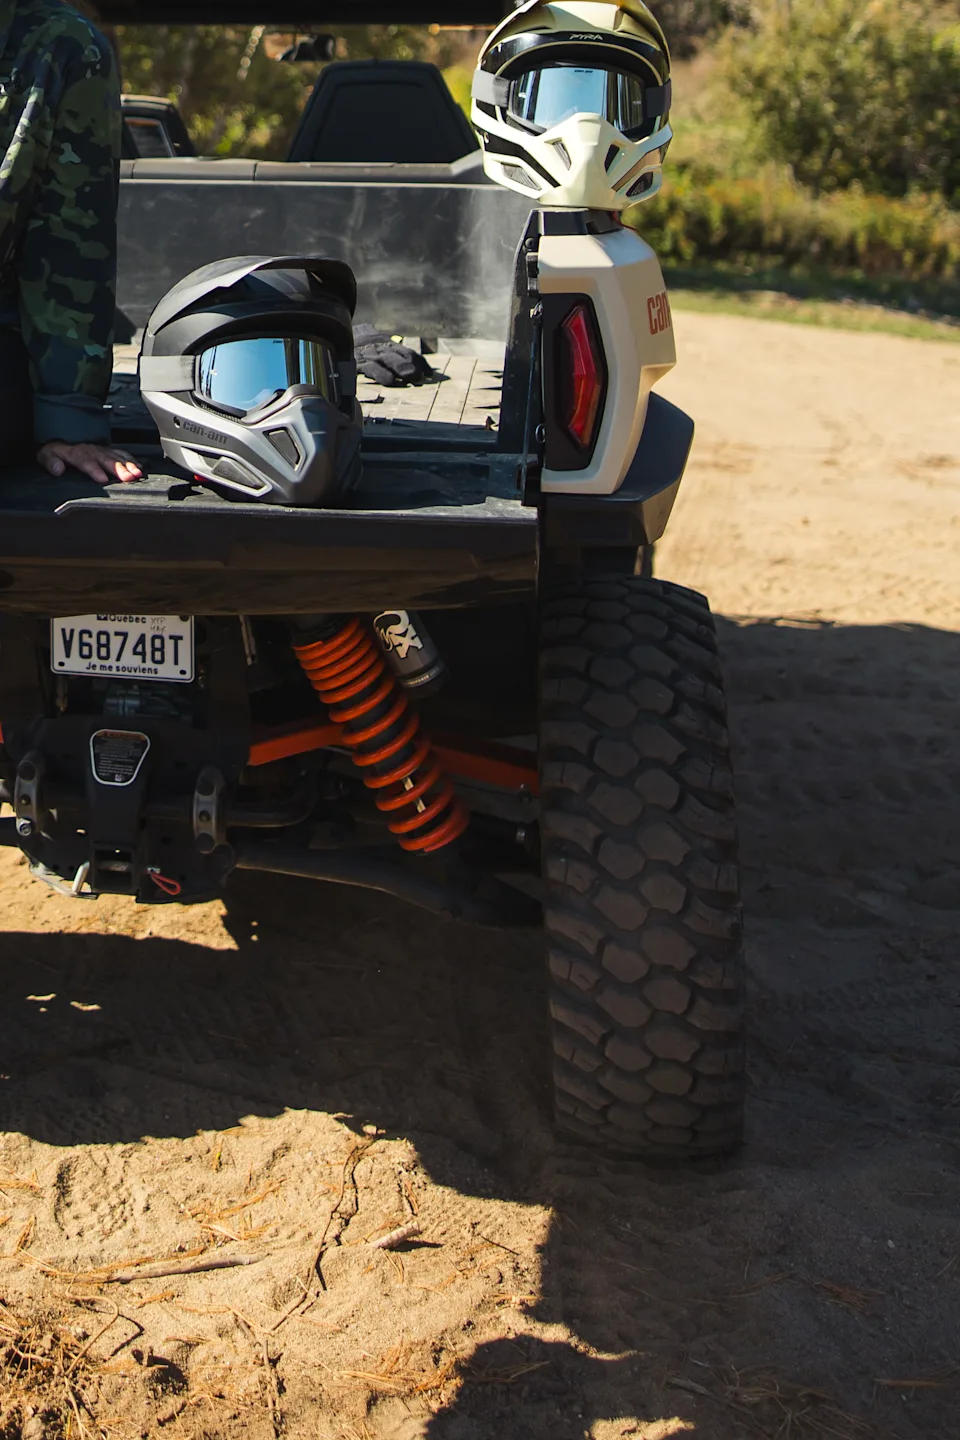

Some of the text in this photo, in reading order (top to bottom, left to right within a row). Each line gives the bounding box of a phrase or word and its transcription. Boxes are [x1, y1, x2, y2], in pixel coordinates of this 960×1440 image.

[183, 421, 228, 444] can-am
[60, 627, 184, 666] V68748T
[86, 661, 97, 670] Je
[116, 665, 158, 674] souviens
